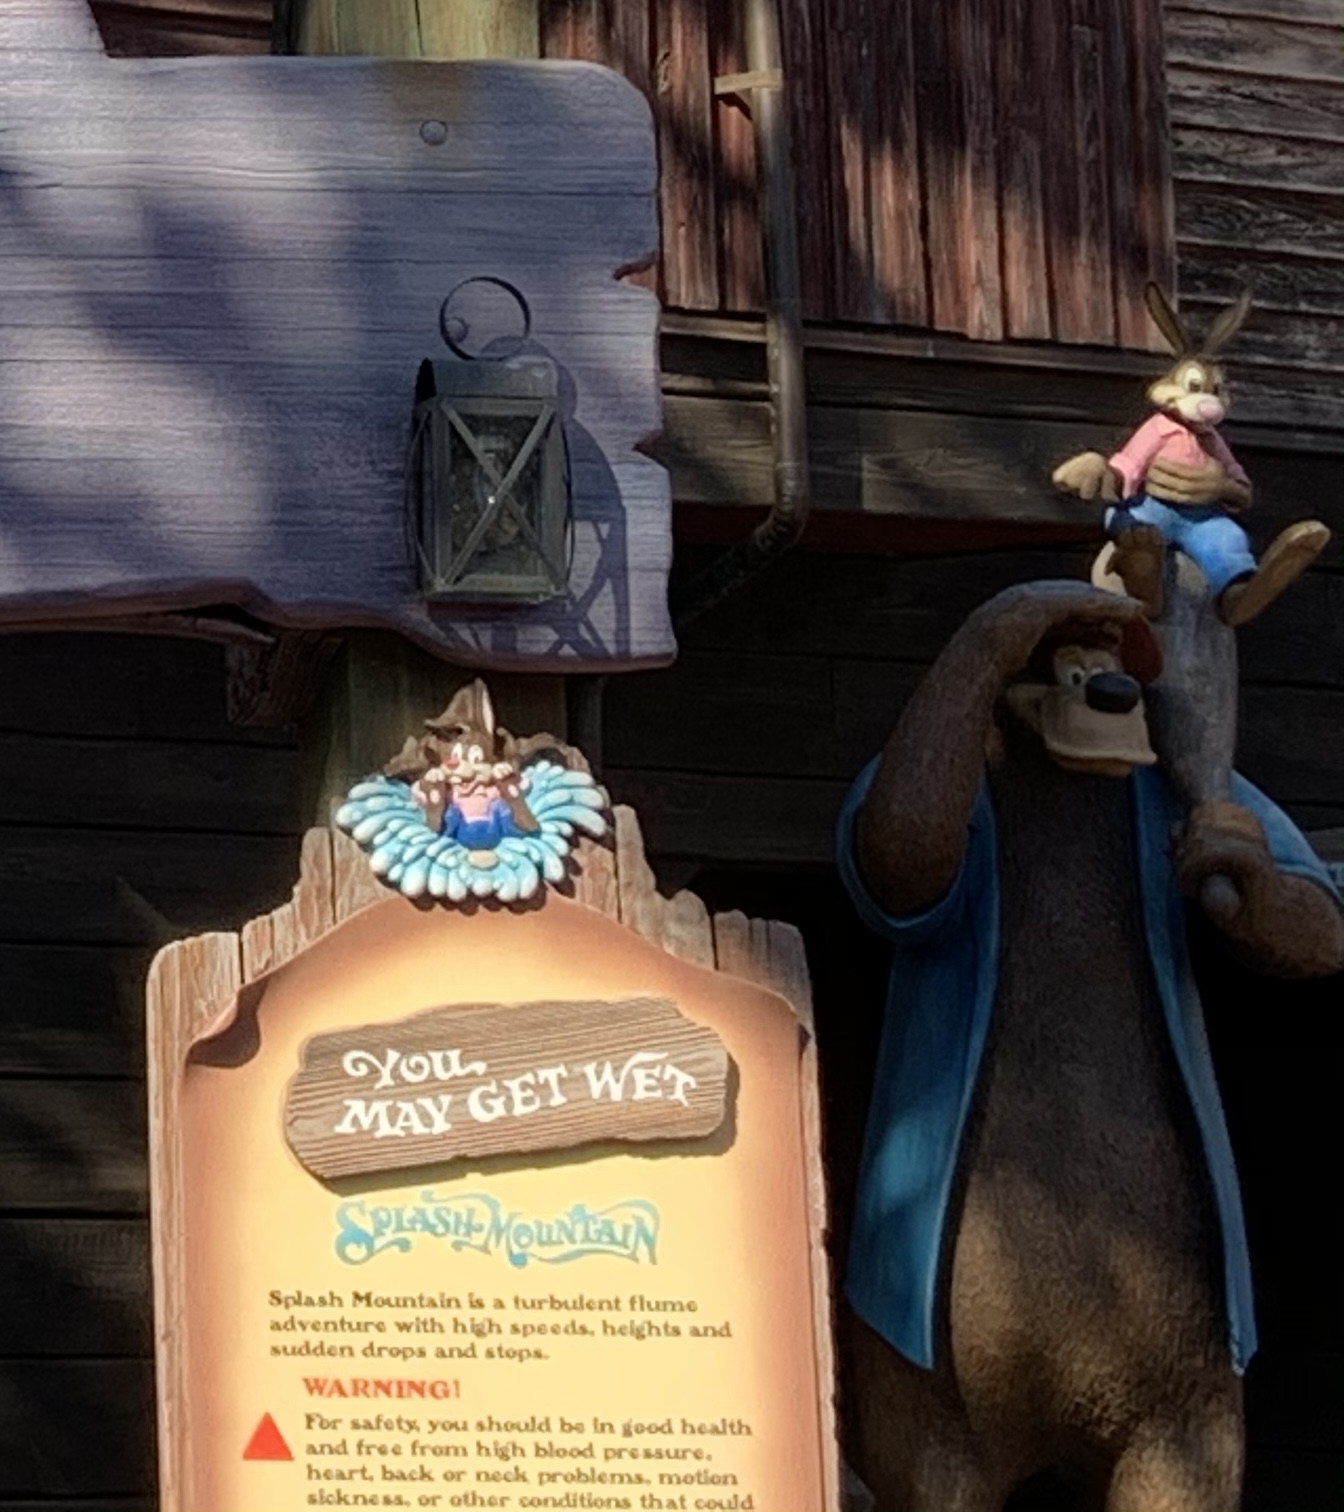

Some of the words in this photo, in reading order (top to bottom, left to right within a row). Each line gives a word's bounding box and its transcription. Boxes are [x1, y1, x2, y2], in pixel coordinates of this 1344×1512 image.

[335, 1094, 453, 1138] MAY
[466, 1062, 568, 1123] GET
[582, 1050, 697, 1107] WET
[334, 1197, 486, 1266] SPLASH
[421, 1189, 660, 1268] MOUNTAIN
[269, 1289, 343, 1310] Splash
[352, 1290, 461, 1309] Mountain
[468, 1292, 484, 1309] is
[493, 1297, 505, 1310] a
[513, 1294, 621, 1312] turbulent
[629, 1294, 698, 1313] flume
[270, 1315, 386, 1332] adventure
[395, 1316, 444, 1333] with
[453, 1317, 502, 1337] high
[603, 1319, 681, 1340] heights
[690, 1320, 732, 1338] and
[270, 1341, 355, 1357] sudden
[362, 1341, 427, 1361] drops
[435, 1343, 477, 1359] and
[485, 1344, 549, 1362] stops.
[302, 1377, 461, 1399] WARNING!
[305, 1412, 343, 1430] For
[427, 1418, 468, 1434] you
[476, 1415, 551, 1433] should
[559, 1416, 584, 1434] be
[594, 1416, 615, 1435] in
[622, 1418, 674, 1438] good
[681, 1418, 752, 1436] health
[306, 1439, 348, 1456] and
[357, 1439, 403, 1456] free
[412, 1440, 468, 1457] from
[476, 1440, 525, 1461] high
[535, 1441, 595, 1459] blood
[382, 1464, 434, 1481] back
[443, 1468, 467, 1482] or
[476, 1465, 528, 1484] neck
[659, 1468, 738, 1486] motion
[418, 1494, 441, 1507] or
[450, 1490, 511, 1508] other
[519, 1491, 631, 1510] conditions
[641, 1492, 687, 1510] that
[695, 1493, 754, 1511] could
